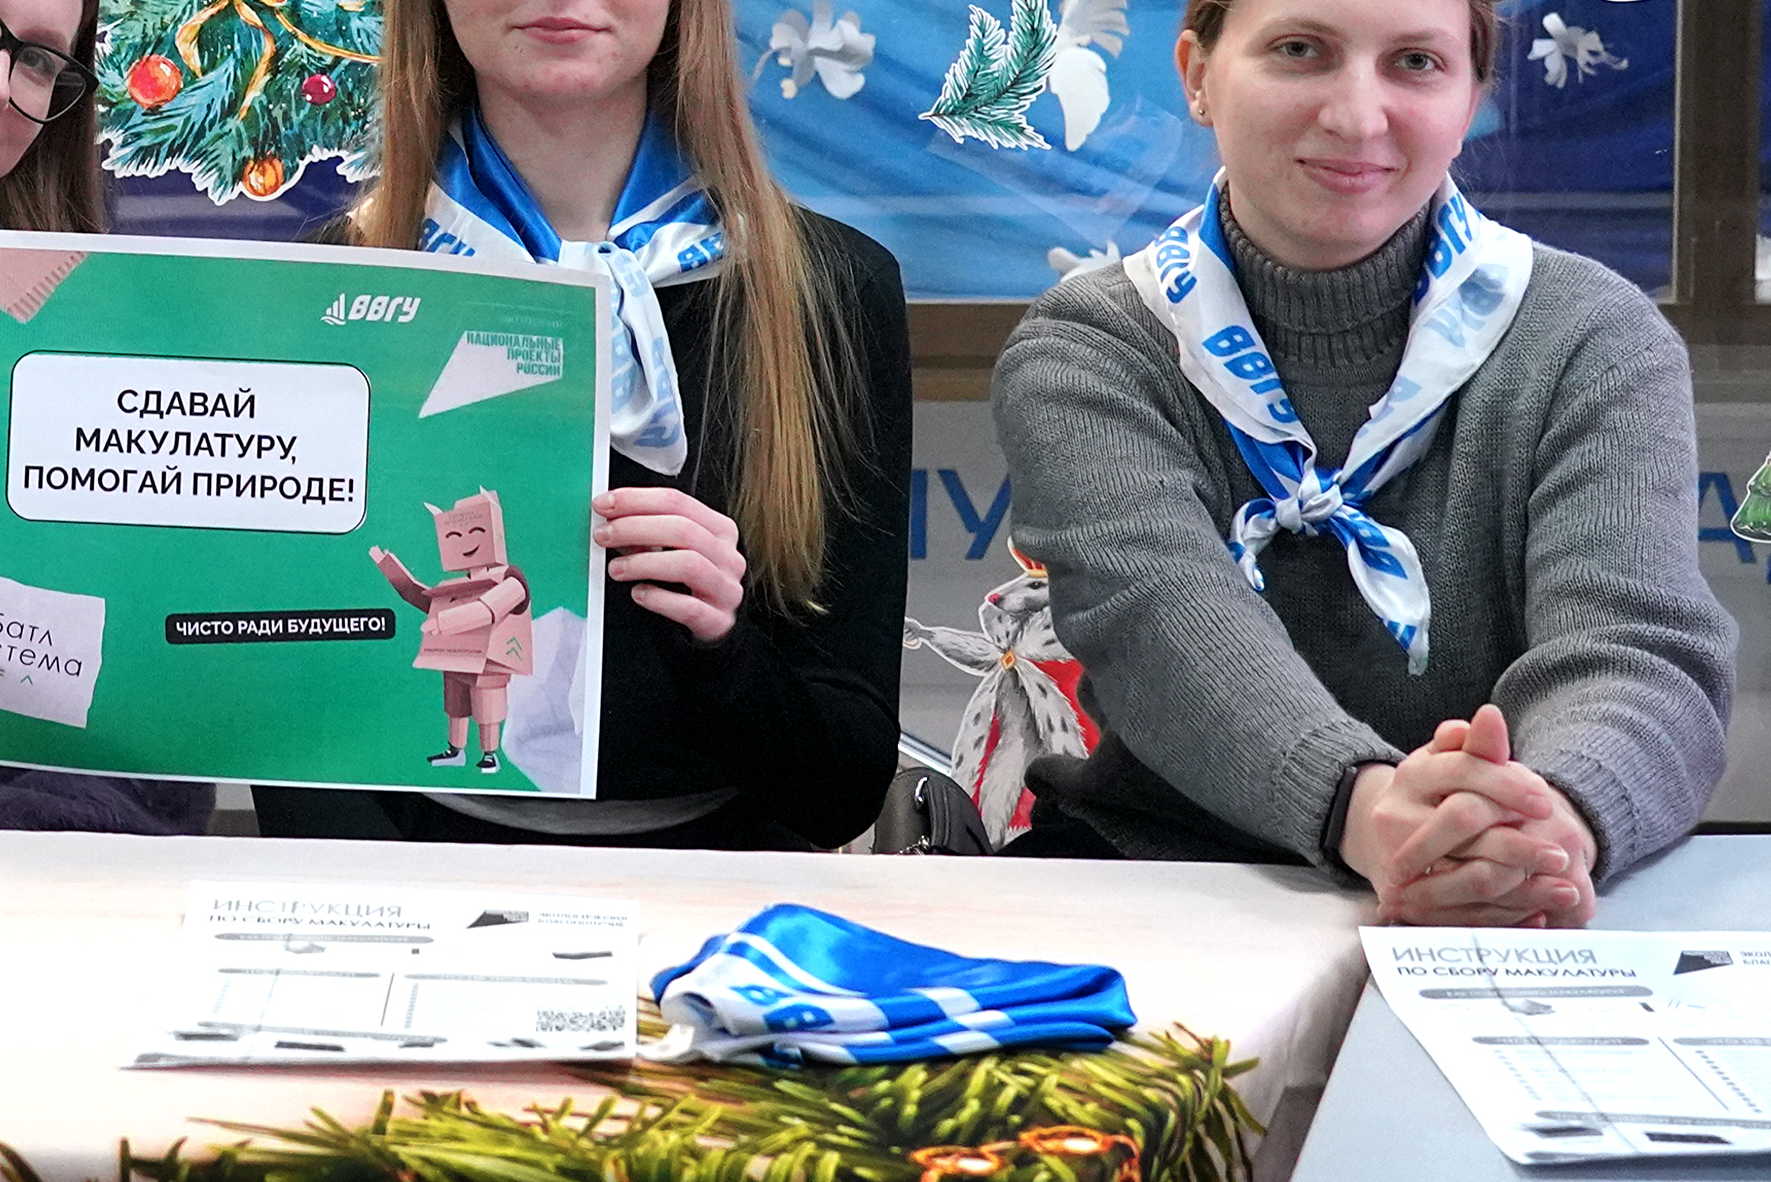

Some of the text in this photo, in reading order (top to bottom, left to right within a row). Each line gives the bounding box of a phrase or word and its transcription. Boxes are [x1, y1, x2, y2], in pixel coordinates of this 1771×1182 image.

[1151, 226, 1197, 304] ВВГУ
[348, 294, 421, 323] ВВГУ
[466, 331, 561, 350] НАЦИОНАЛЬНЫЕ
[506, 348, 561, 363] ПРОЕКТЫ
[516, 362, 561, 377] РОССИИ
[1202, 325, 1299, 424] ВВГУ
[116, 387, 256, 420] СДАВАЙ
[75, 427, 298, 464] МАКУЛАТУРУ,
[23, 465, 355, 505] ПОМОГАЙ ПРИРОДЕ!
[175, 616, 386, 636] ЧИСТО РАДИ БУДУЩЕГО!
[213, 899, 402, 919] ИНСТРУКЦИЯ
[209, 914, 431, 930] ПО СБОРУ МАКУЛАТУРЫ
[1392, 946, 1597, 965] ИНСТРУКЦИЯ
[1396, 967, 1638, 979] ПО СБОРУ МАКУЛАТУРЫ
